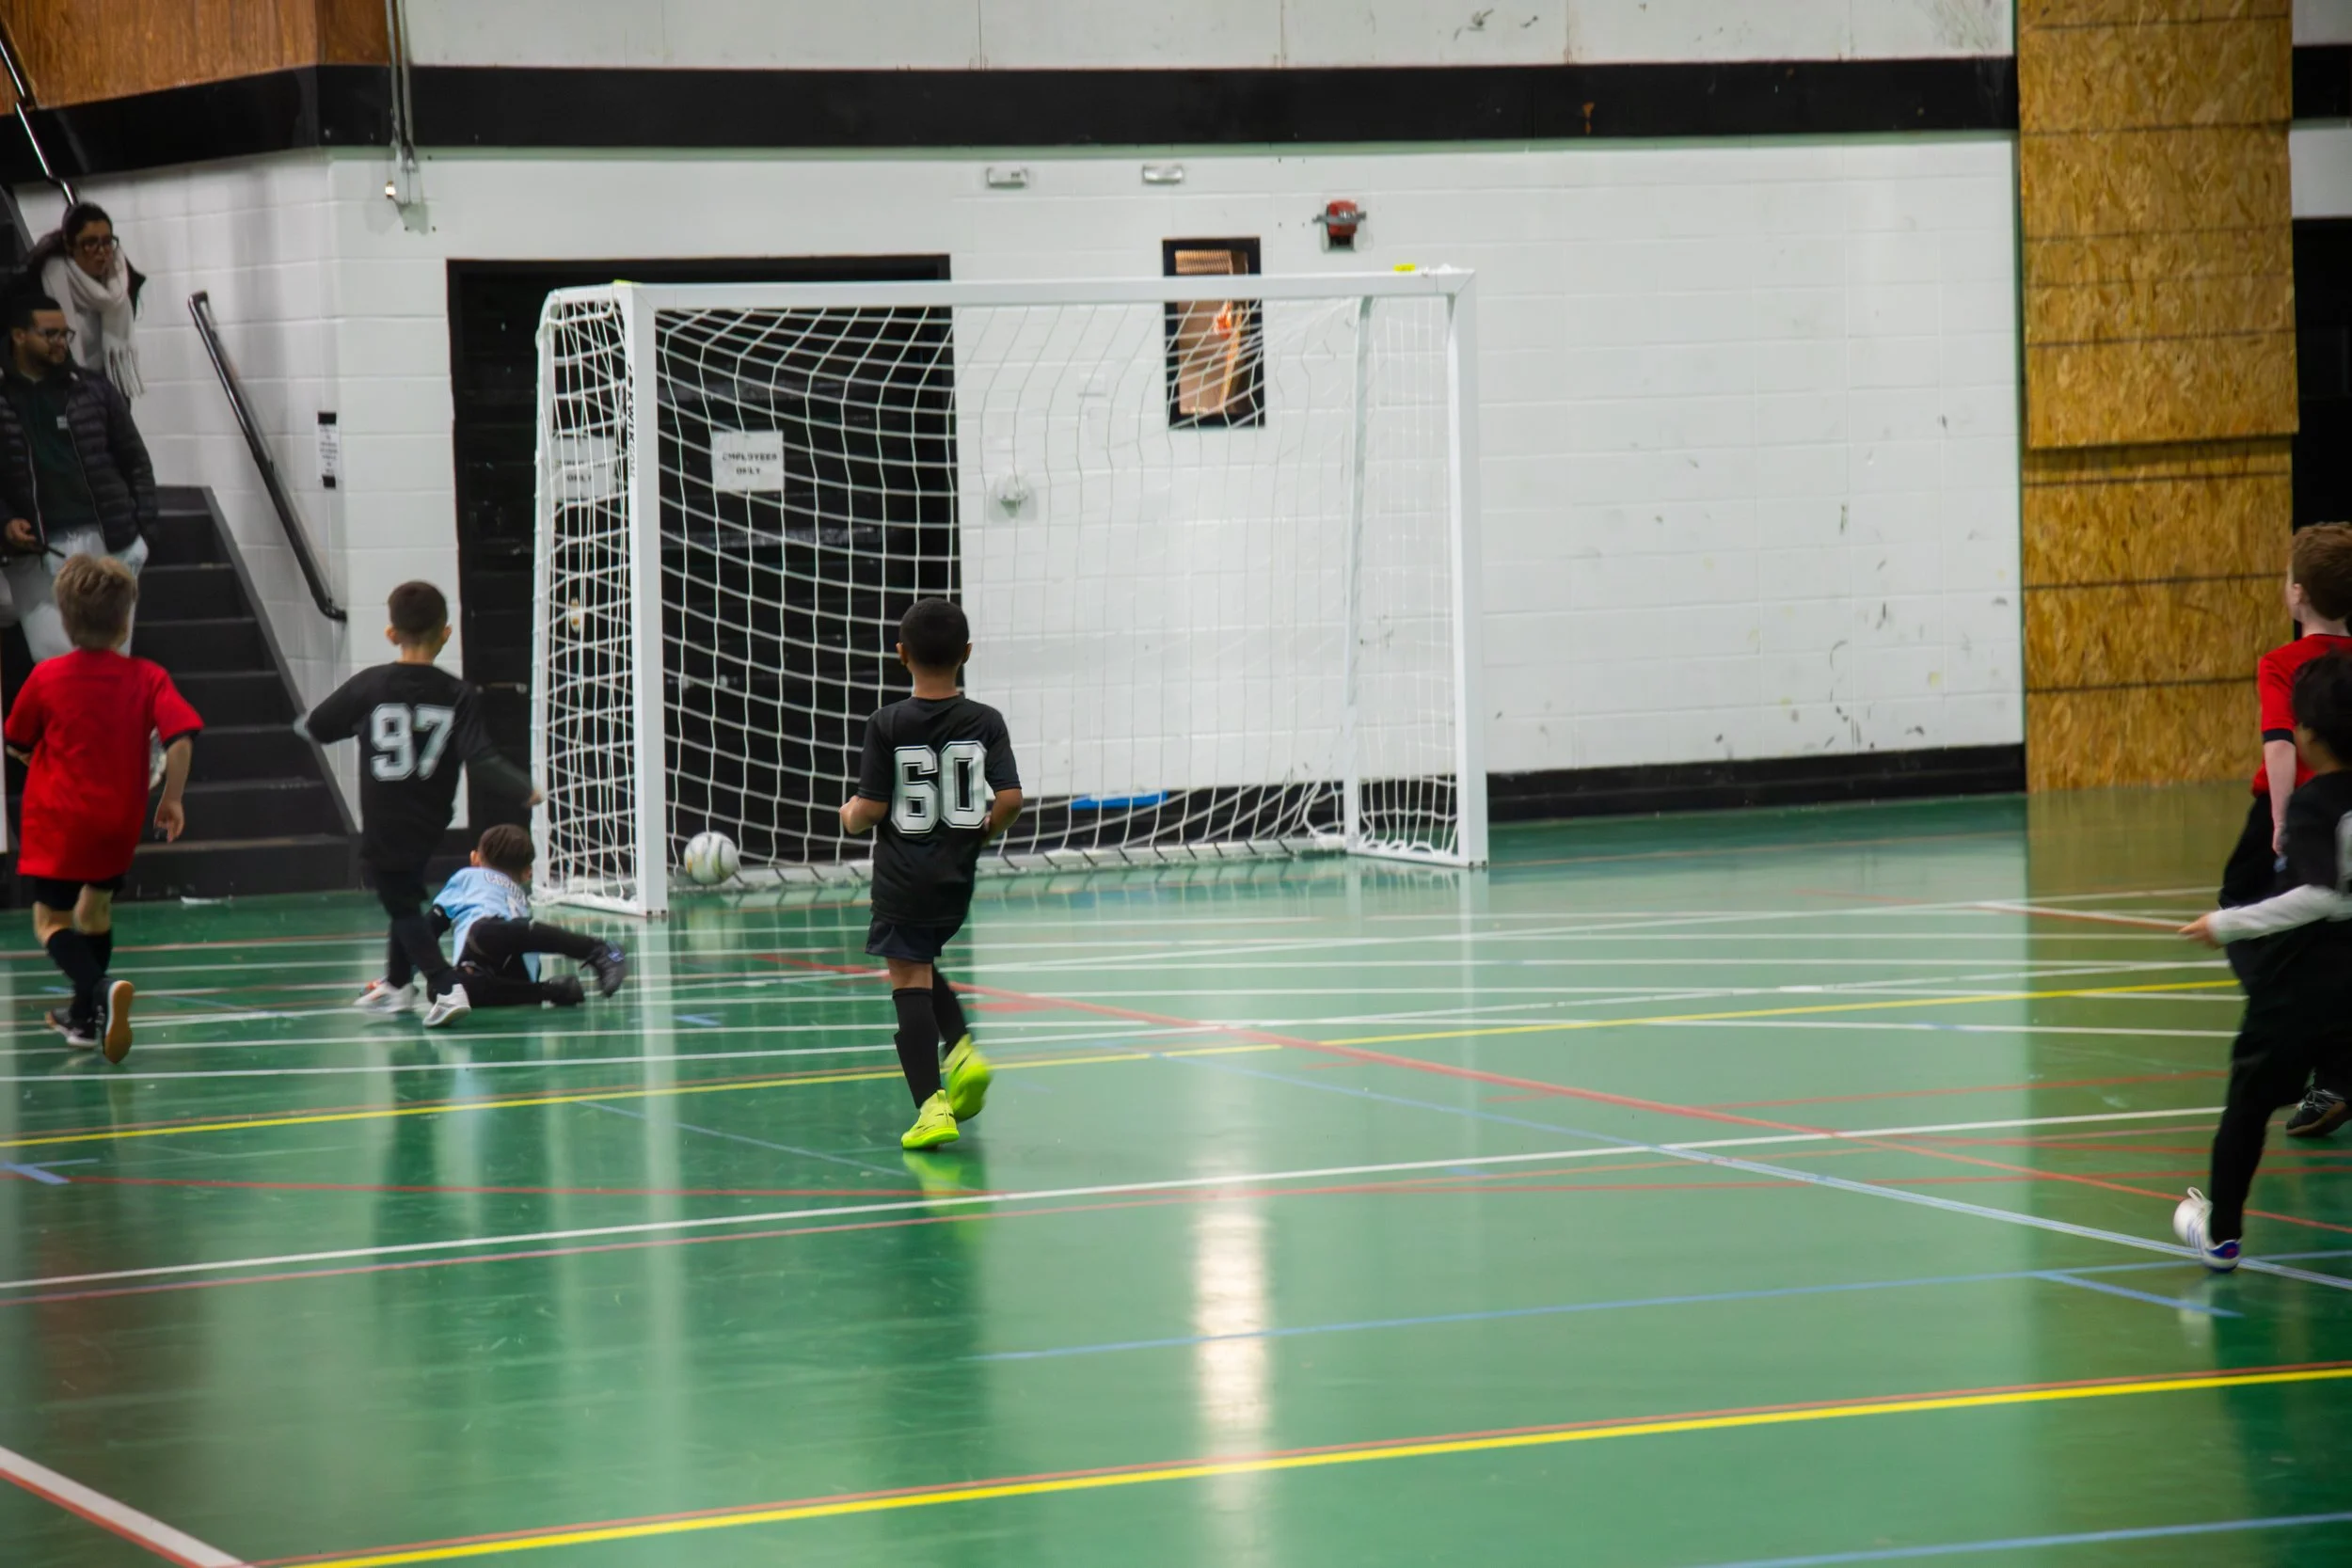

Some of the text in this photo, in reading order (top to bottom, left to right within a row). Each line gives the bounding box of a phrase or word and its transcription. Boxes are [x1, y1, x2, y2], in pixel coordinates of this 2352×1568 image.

[722, 452, 778, 462] EMPLOYEES
[736, 466, 760, 475] ONLY
[370, 703, 455, 782] 97
[891, 740, 987, 834] 60
